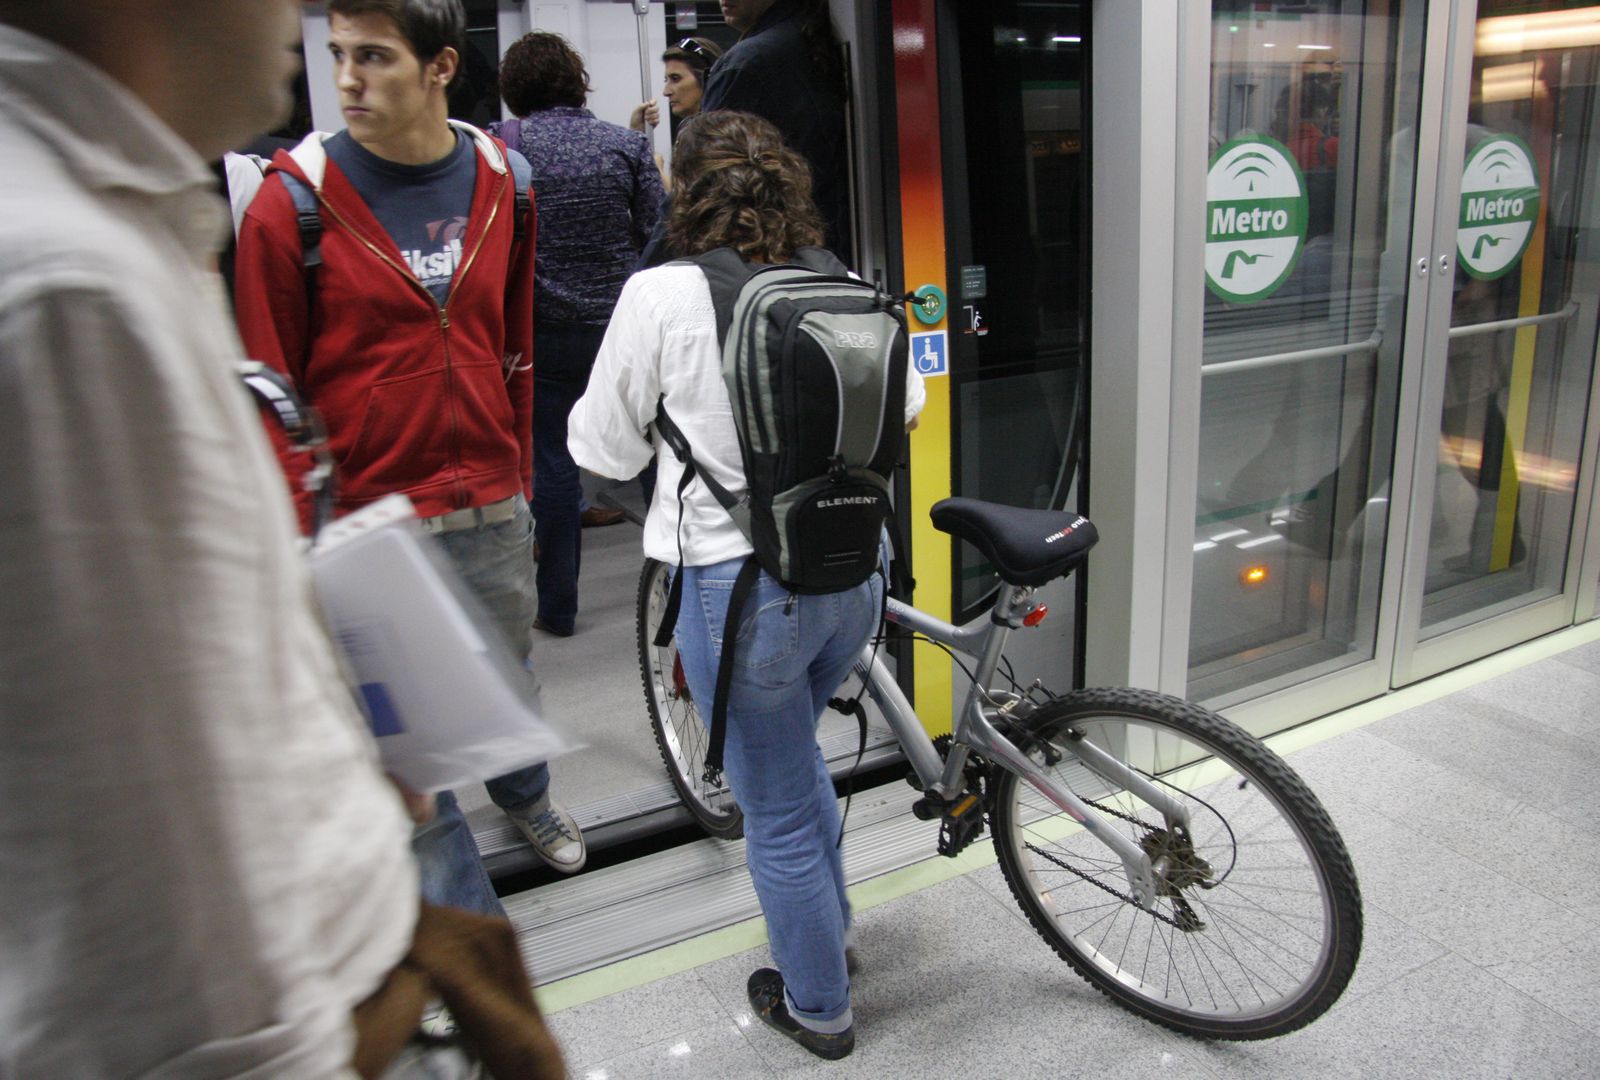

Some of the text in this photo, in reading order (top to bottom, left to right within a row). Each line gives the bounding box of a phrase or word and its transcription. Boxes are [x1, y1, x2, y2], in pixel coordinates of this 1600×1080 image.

[1211, 207, 1288, 235] Metro
[1465, 197, 1524, 221] Metro
[817, 496, 879, 508] ELEMENT
